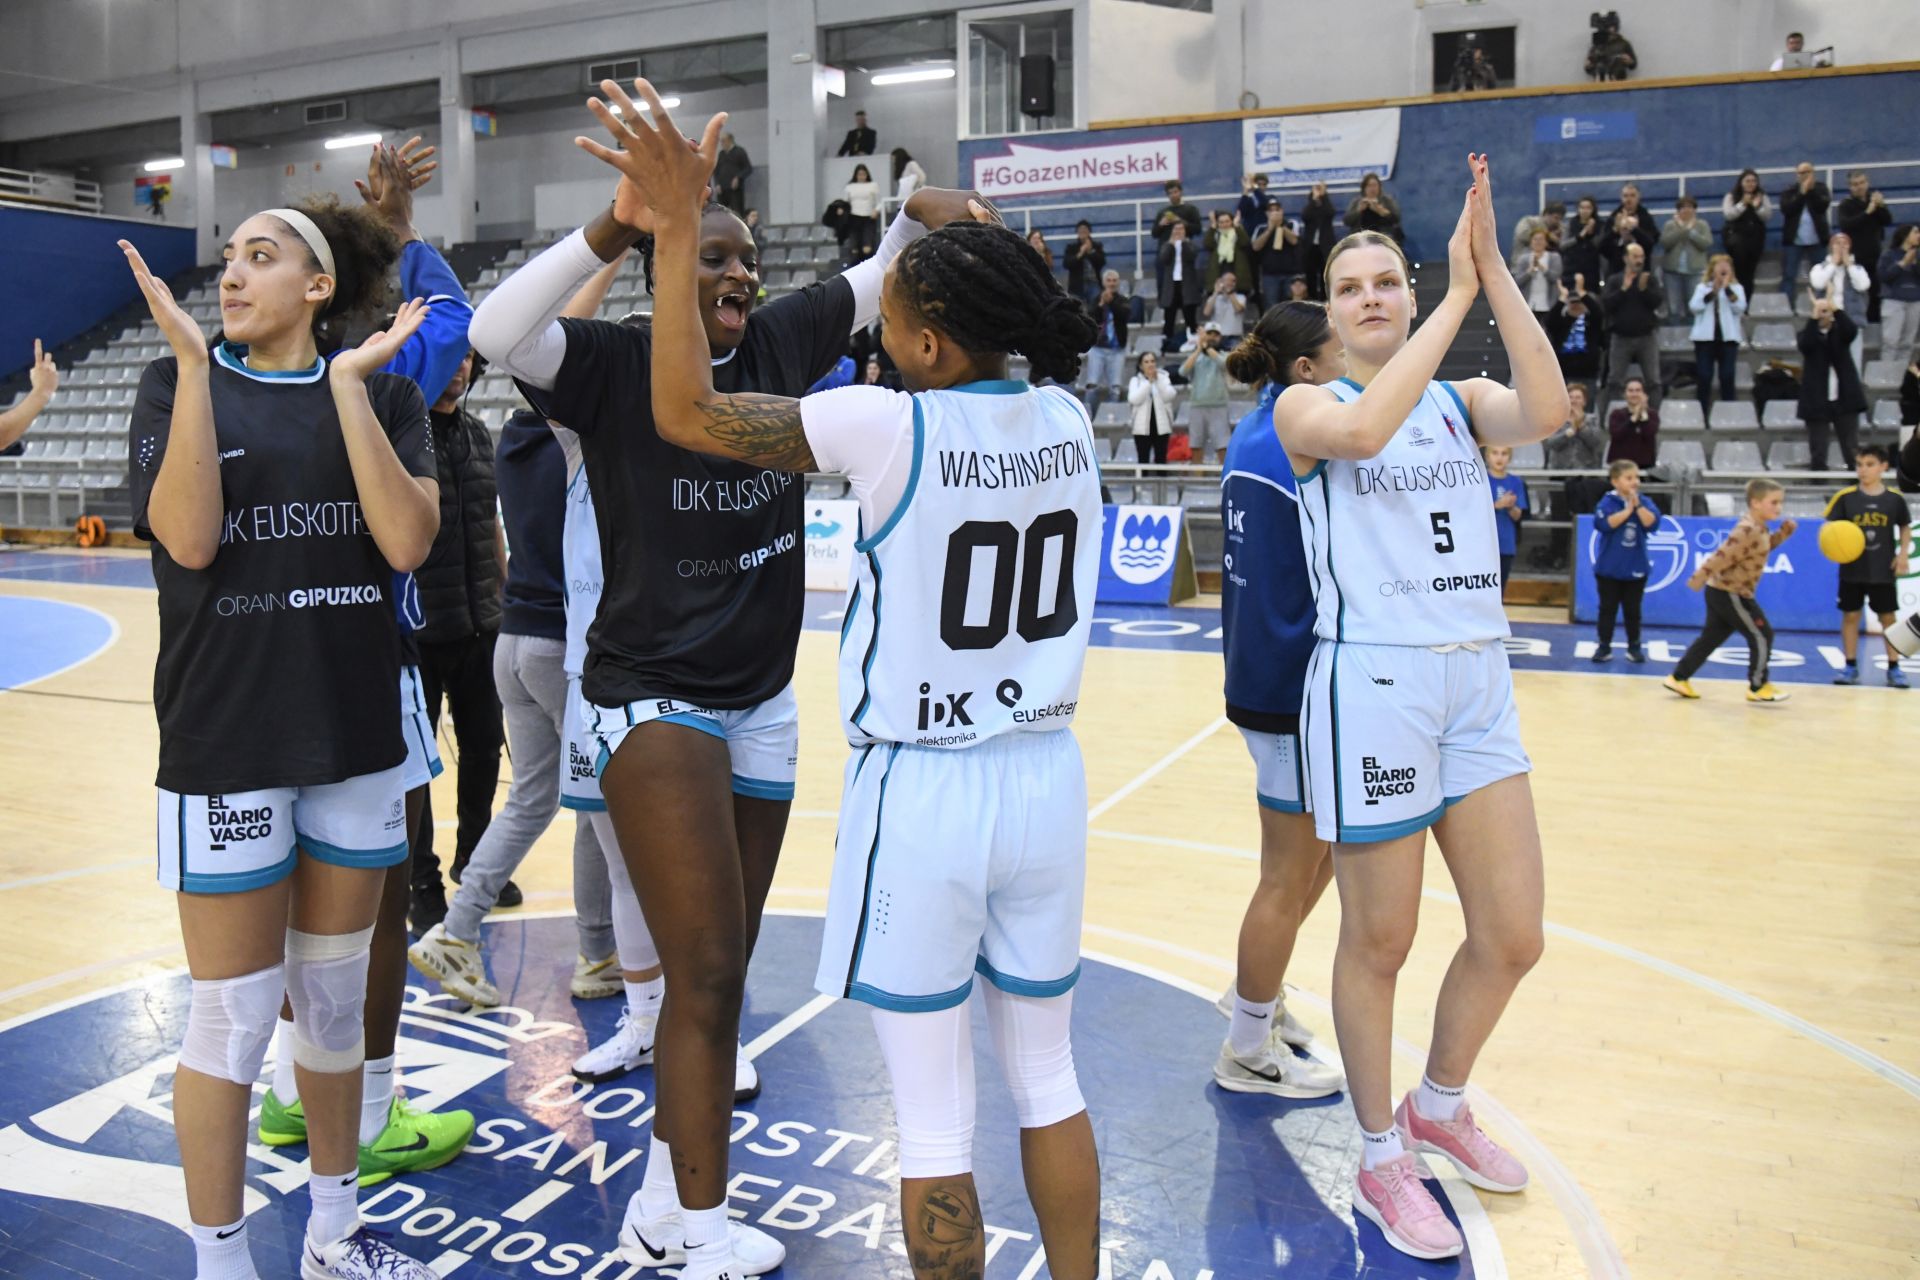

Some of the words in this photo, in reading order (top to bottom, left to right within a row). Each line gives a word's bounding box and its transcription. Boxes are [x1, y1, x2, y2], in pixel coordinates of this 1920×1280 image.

[981, 152, 1168, 187] #GoazenNeskak
[223, 448, 245, 459] WIBO
[939, 438, 1089, 489] WASHINGTON
[1354, 465, 1388, 496] IDK
[673, 478, 711, 511] IDK
[1430, 511, 1455, 554] 5
[677, 557, 738, 578] ORAIN
[940, 508, 1079, 651] 00
[1379, 579, 1431, 597] ORAIN
[216, 592, 286, 616] ORAIN
[656, 700, 679, 714] EL
[570, 741, 580, 754] EL
[916, 731, 977, 747] elektronika
[570, 765, 597, 778] VASC
[1362, 757, 1381, 770] EL
[1363, 767, 1416, 784] DIARIO
[1365, 781, 1415, 798] VASCO
[208, 795, 229, 809] EL
[208, 806, 273, 826] DIARIO
[210, 823, 272, 842] VASCO
[462, 1117, 643, 1185] SAN
